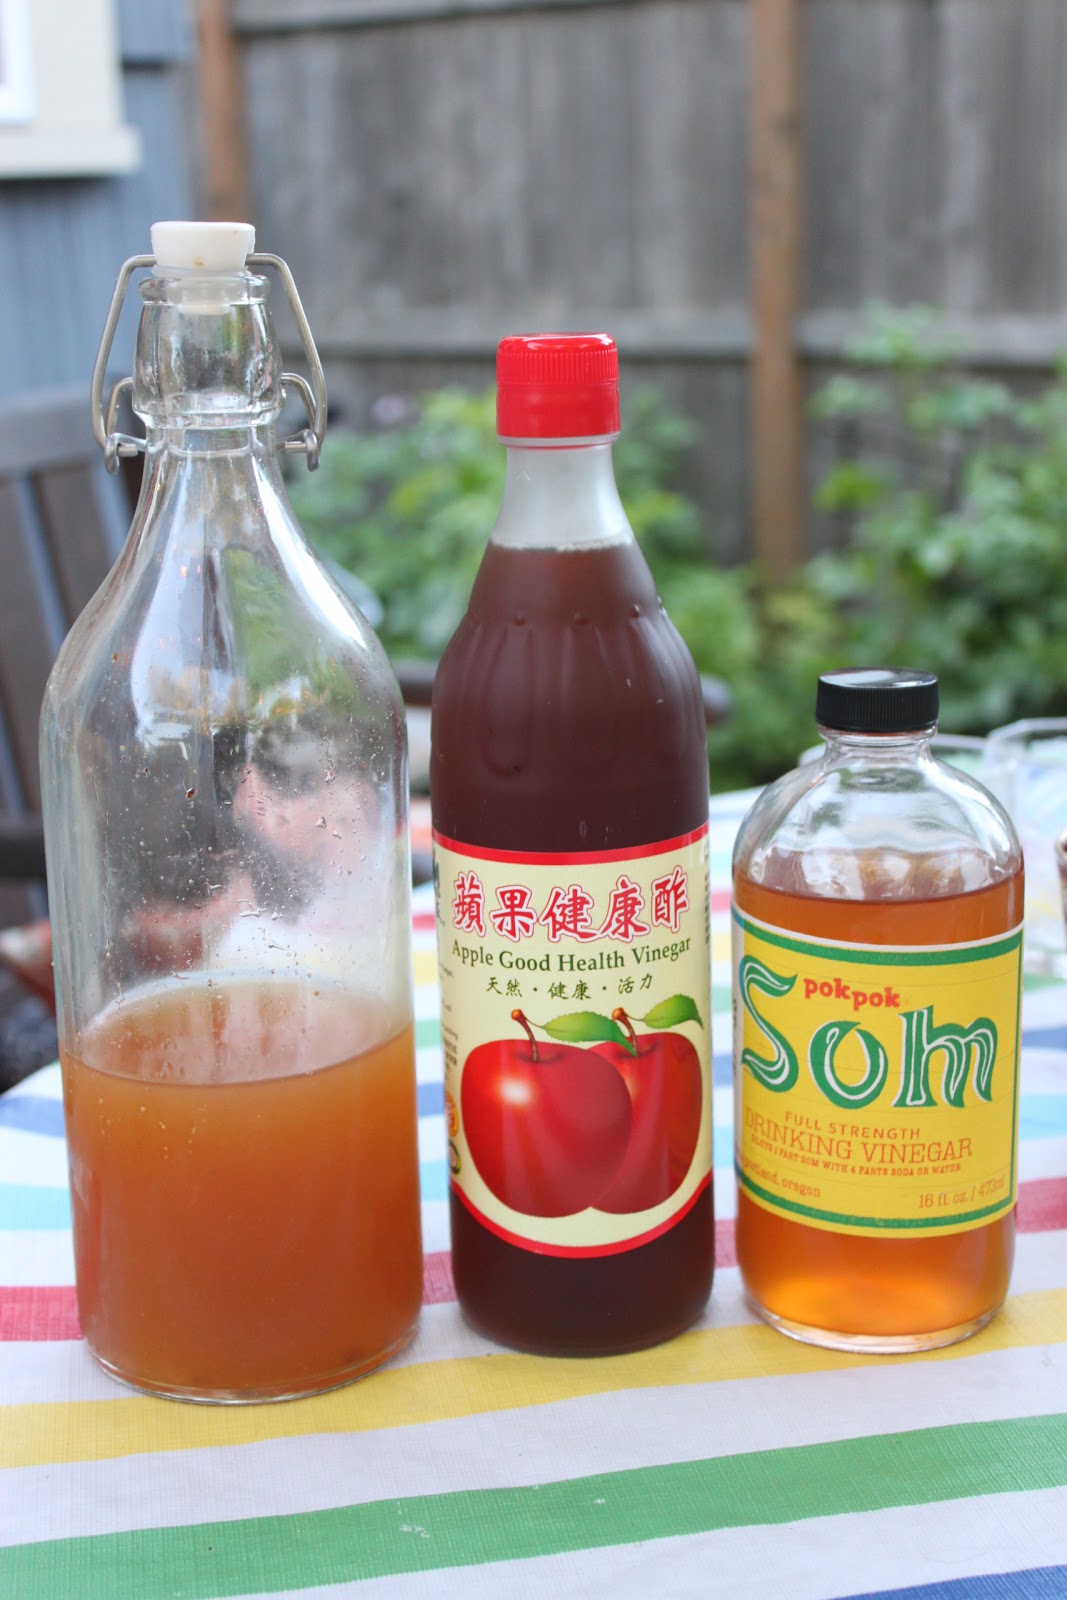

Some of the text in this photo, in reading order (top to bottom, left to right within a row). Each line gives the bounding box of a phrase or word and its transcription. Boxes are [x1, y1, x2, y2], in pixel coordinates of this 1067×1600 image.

[452, 937, 691, 972] Apple Good Health Vinegar
[739, 954, 998, 1109] Som
[745, 1105, 972, 1164] DRINKING VINEGAR
[785, 1111, 920, 1140] FULL STRENGTH
[779, 1148, 799, 1162] PART
[801, 1156, 819, 1168] SOM
[822, 1160, 848, 1173] WITH
[850, 1165, 856, 1174] 4
[859, 1165, 888, 1177] PARTS
[891, 1167, 914, 1177] SODA
[917, 1167, 929, 1176] OR
[932, 1163, 961, 1175] WATER
[781, 1178, 820, 1198] oregon
[919, 1193, 934, 1208] 16
